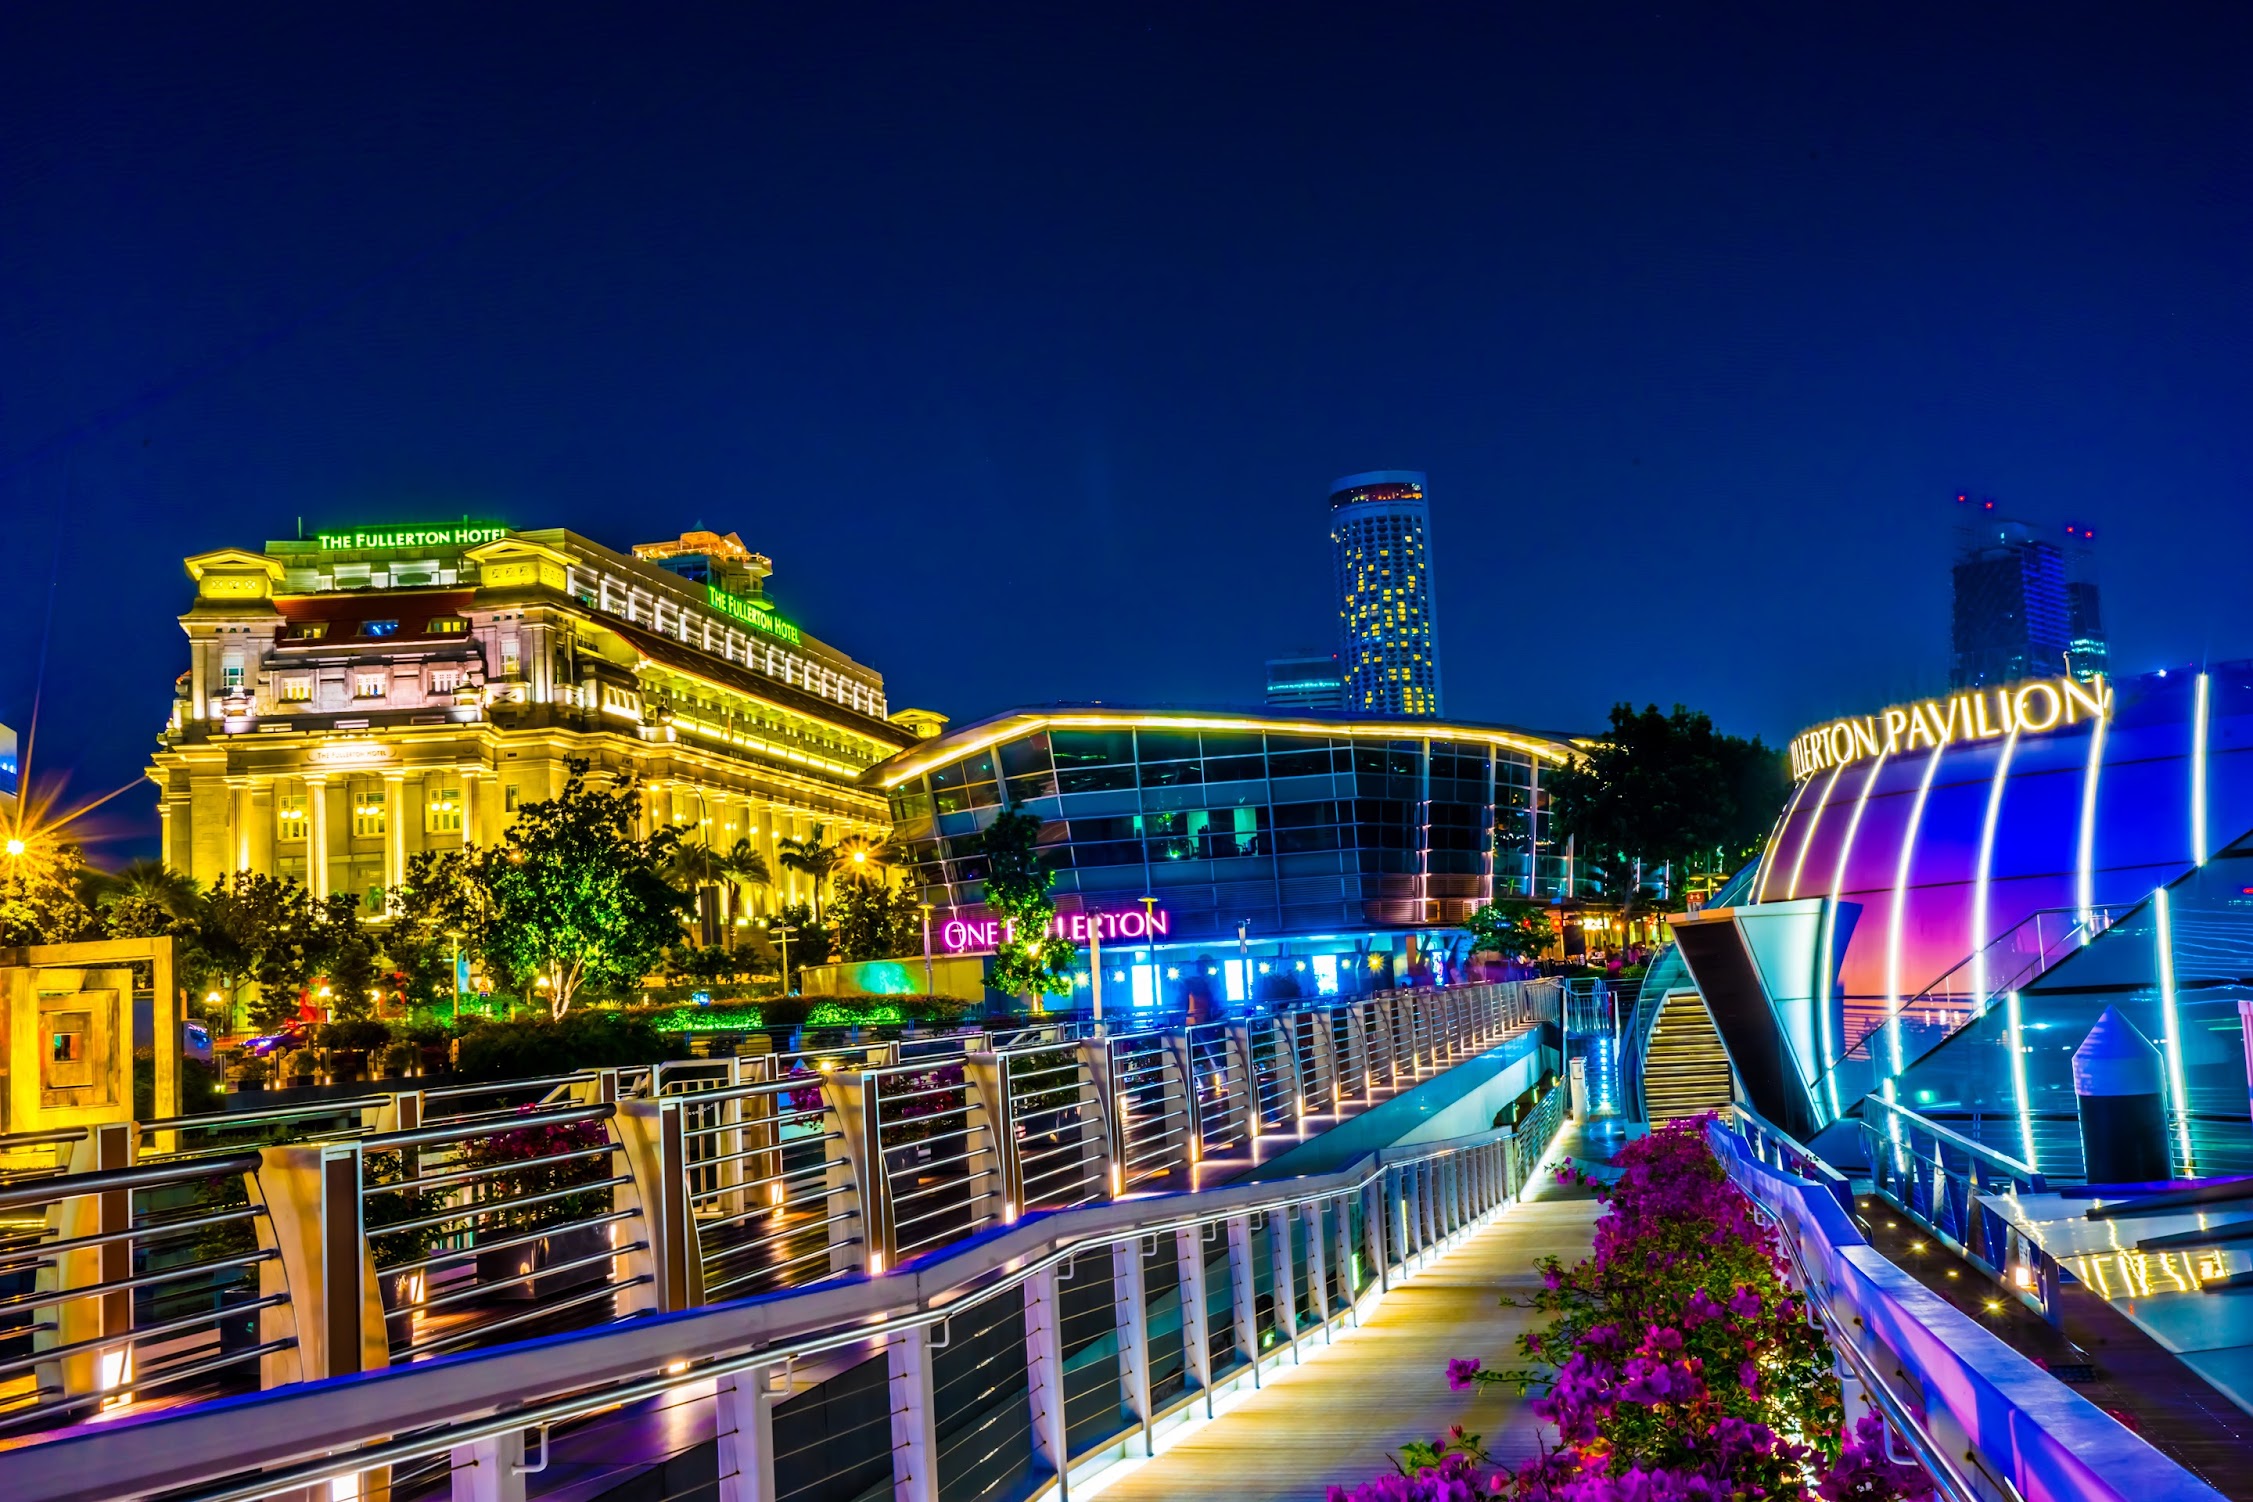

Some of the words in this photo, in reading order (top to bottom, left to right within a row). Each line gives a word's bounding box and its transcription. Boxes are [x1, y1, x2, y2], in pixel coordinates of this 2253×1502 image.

[319, 535, 351, 549] THE
[356, 531, 450, 548] FULLERTON
[708, 586, 726, 611] THE
[728, 595, 773, 632] FULLERTON
[774, 616, 800, 644] HOTEL
[1885, 673, 2104, 753] PAVILION
[944, 920, 999, 948] ONE
[1006, 910, 1168, 944] FLERTON
